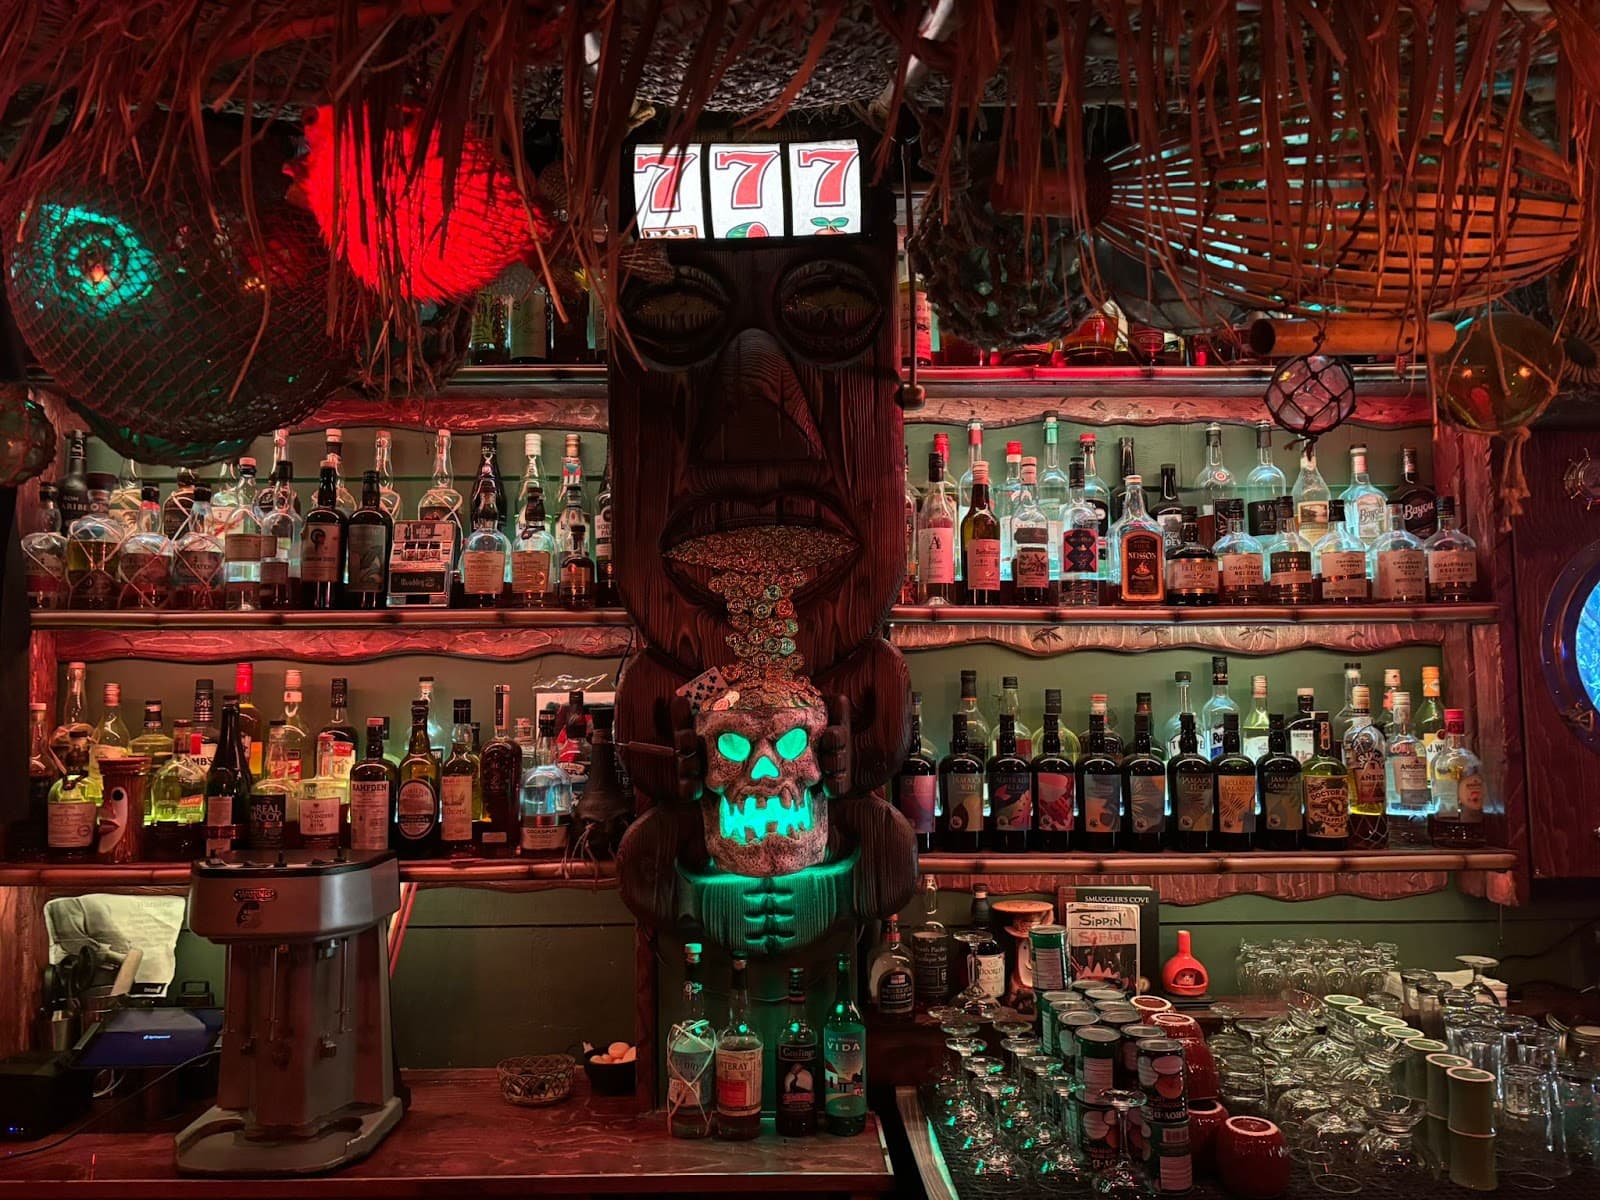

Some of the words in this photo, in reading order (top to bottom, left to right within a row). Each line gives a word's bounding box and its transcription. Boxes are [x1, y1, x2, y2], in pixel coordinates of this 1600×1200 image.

[635, 153, 698, 213] 7
[715, 150, 780, 209] 7
[798, 149, 859, 207] 7
[1360, 507, 1384, 522] Bayou
[1403, 502, 1434, 520] Bayou
[827, 1042, 861, 1052] VIDA
